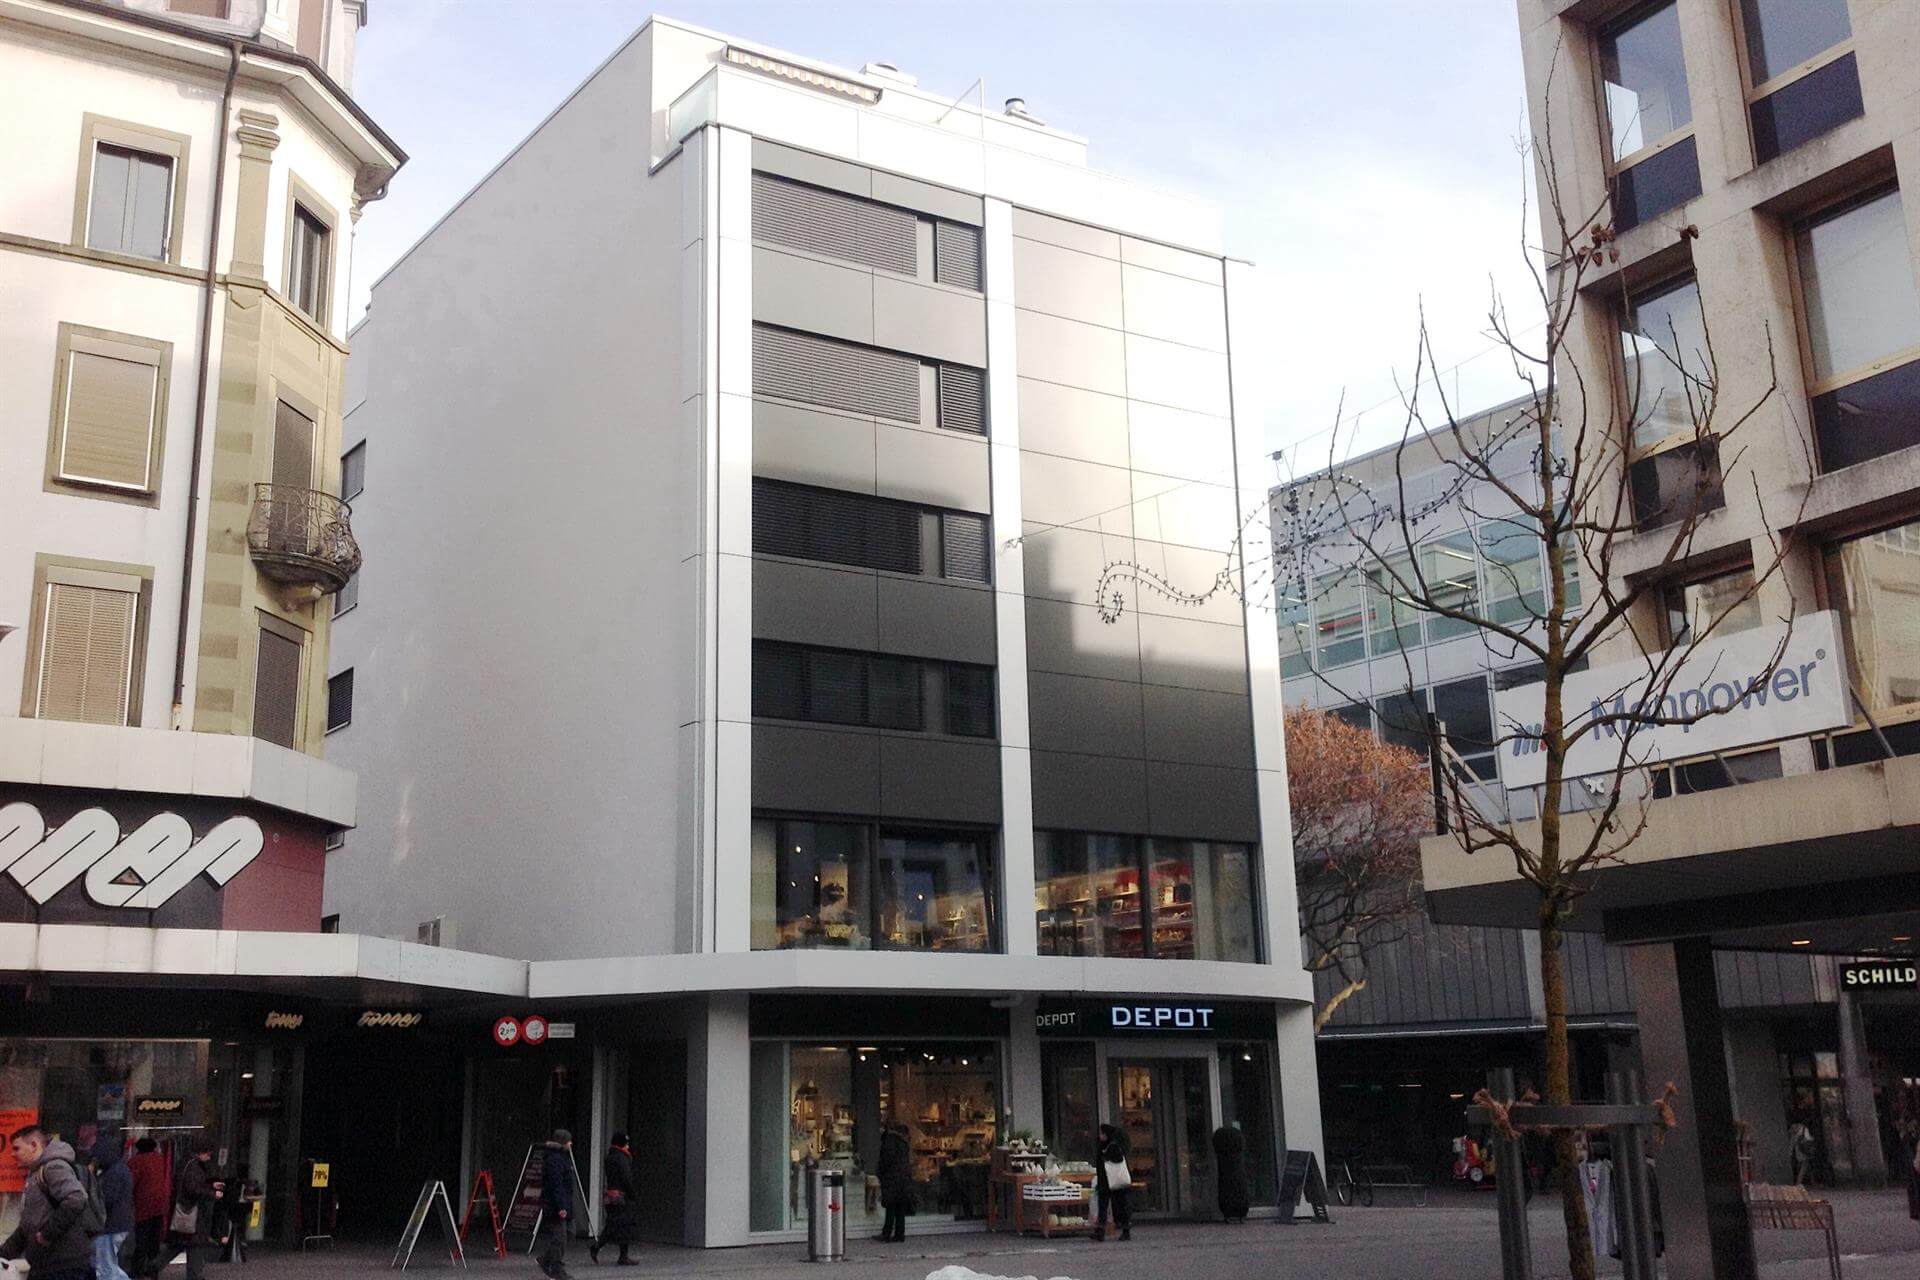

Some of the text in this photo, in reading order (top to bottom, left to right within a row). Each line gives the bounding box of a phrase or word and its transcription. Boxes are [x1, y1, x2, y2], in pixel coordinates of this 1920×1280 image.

[1590, 660, 1817, 740] Manpower
[1845, 967, 1917, 985] SCHILD
[1036, 1012, 1076, 1027] DEPOT
[1111, 1006, 1214, 1027] DEPOT
